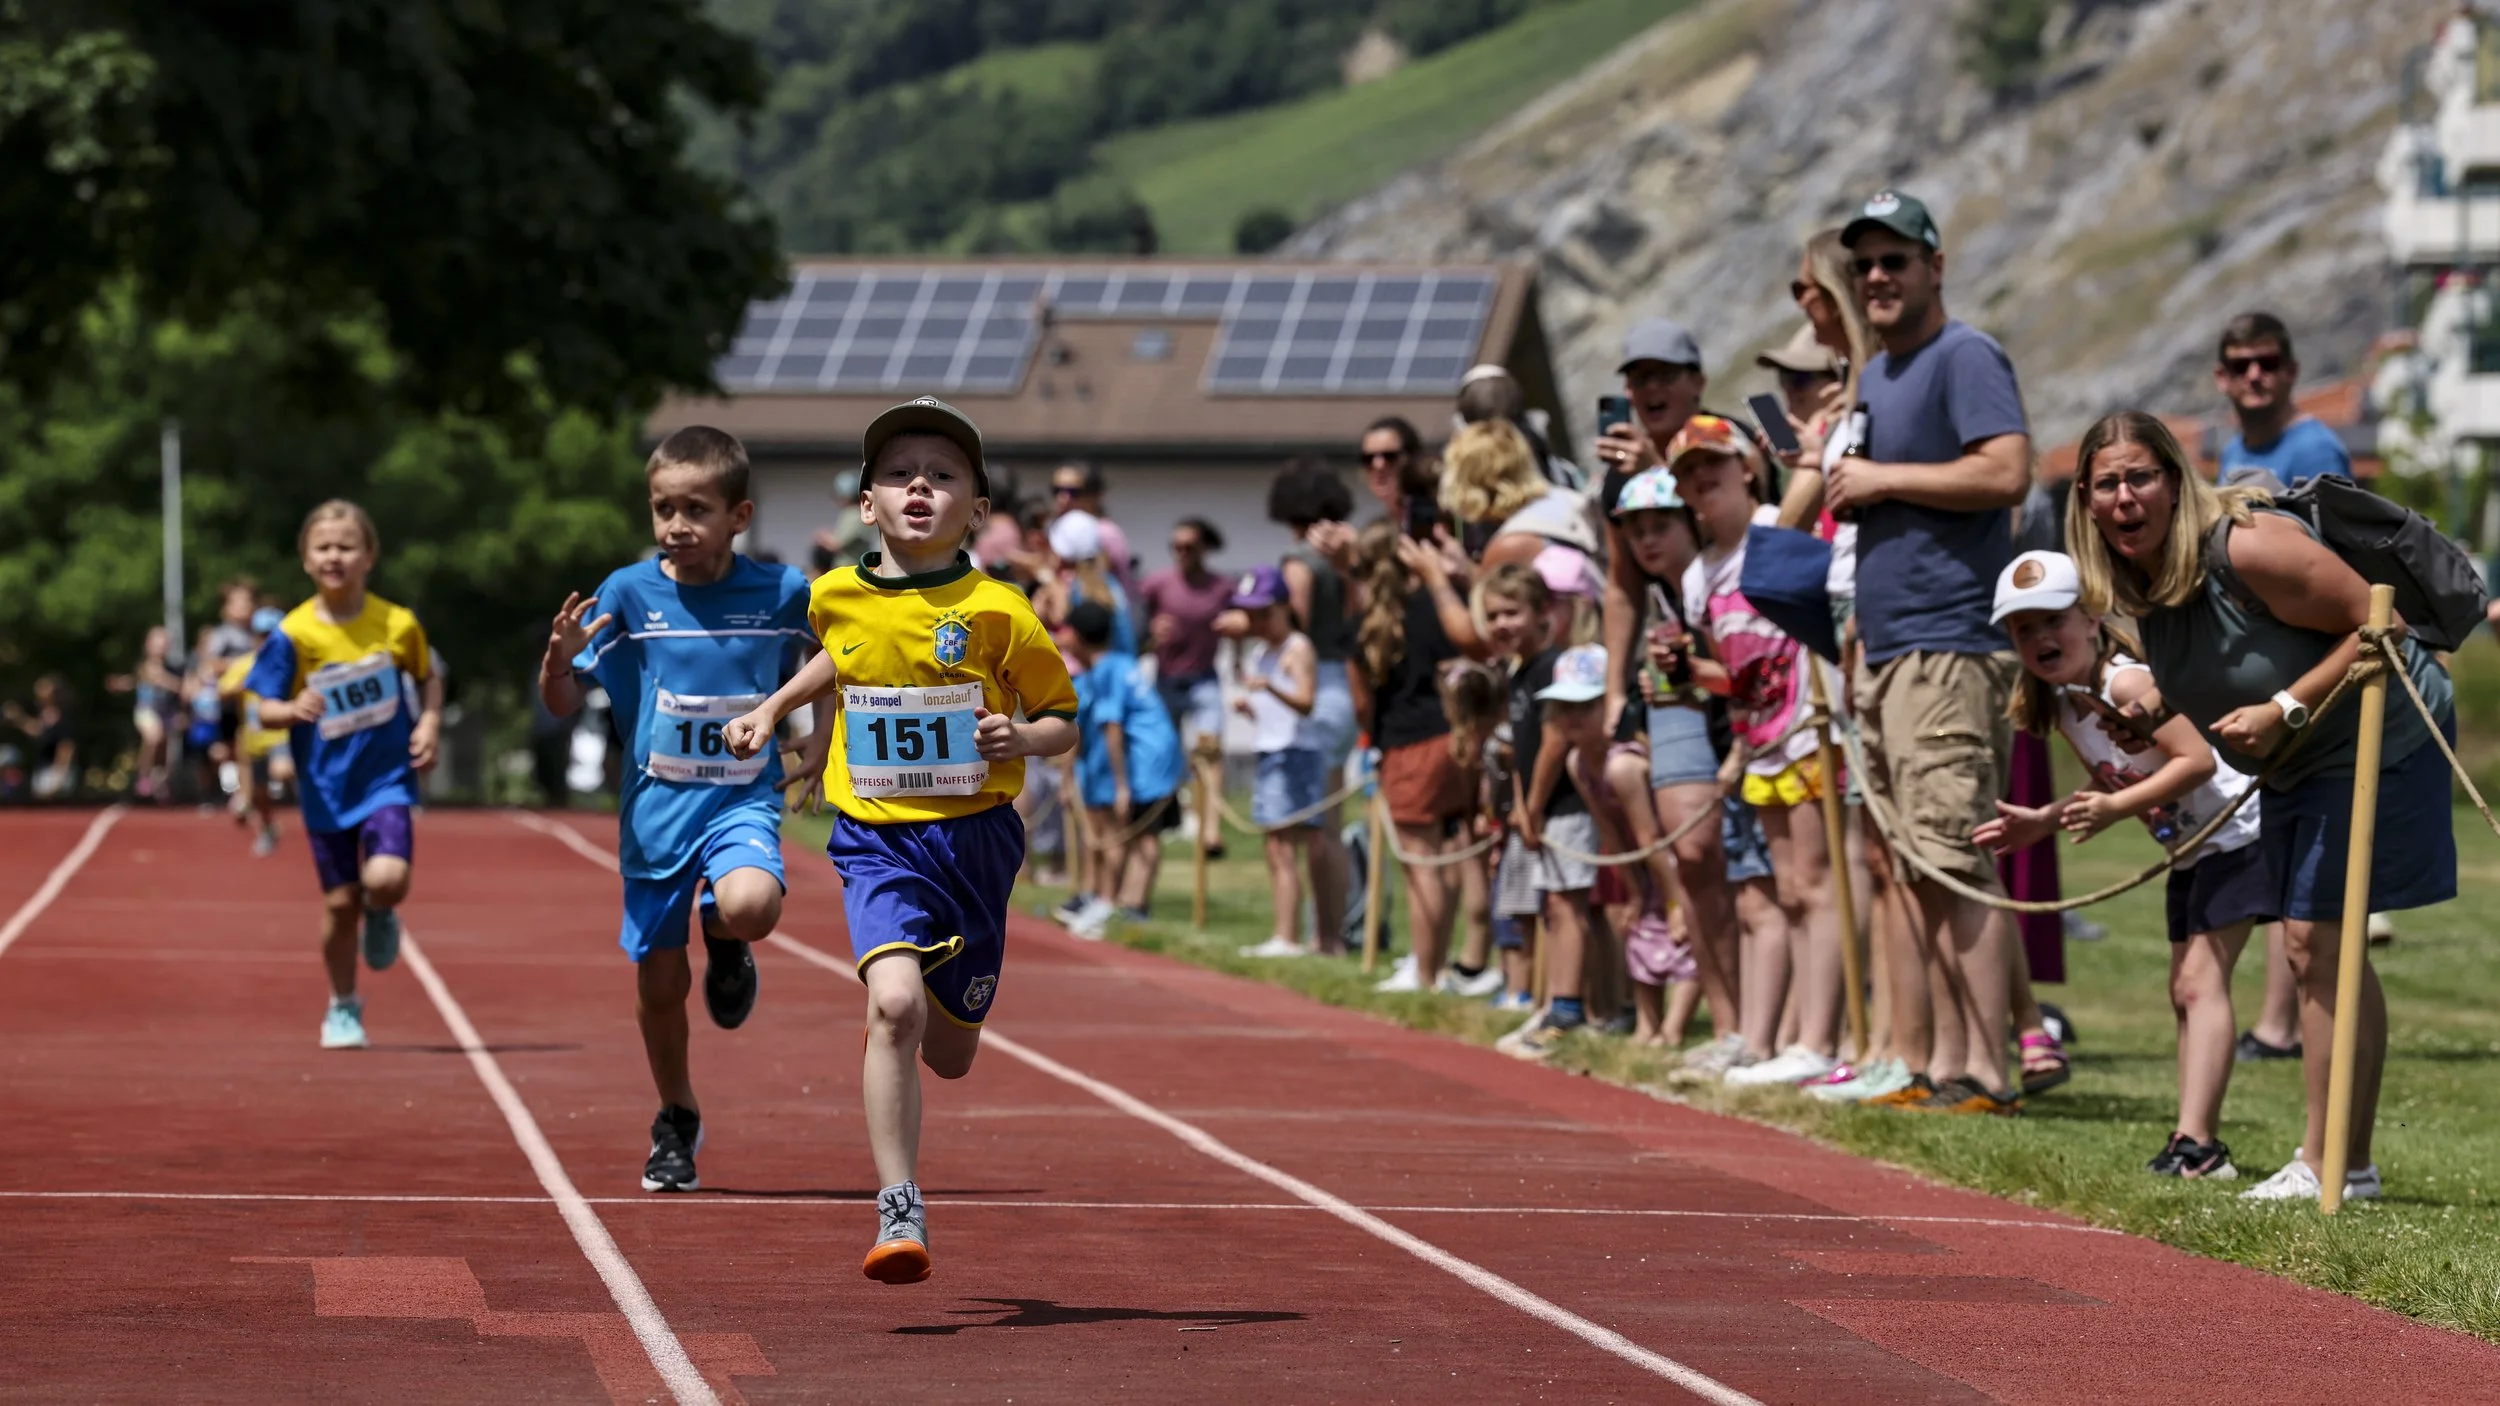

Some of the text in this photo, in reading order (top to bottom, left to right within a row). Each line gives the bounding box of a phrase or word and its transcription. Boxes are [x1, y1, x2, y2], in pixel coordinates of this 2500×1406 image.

[944, 639, 958, 647] CBF
[331, 676, 382, 712] 169
[850, 693, 902, 707] stv gampel
[923, 689, 972, 706] lonzalauf
[676, 720, 736, 757] 16
[868, 717, 950, 761] 151
[936, 772, 986, 785] RAIFFEISEN
